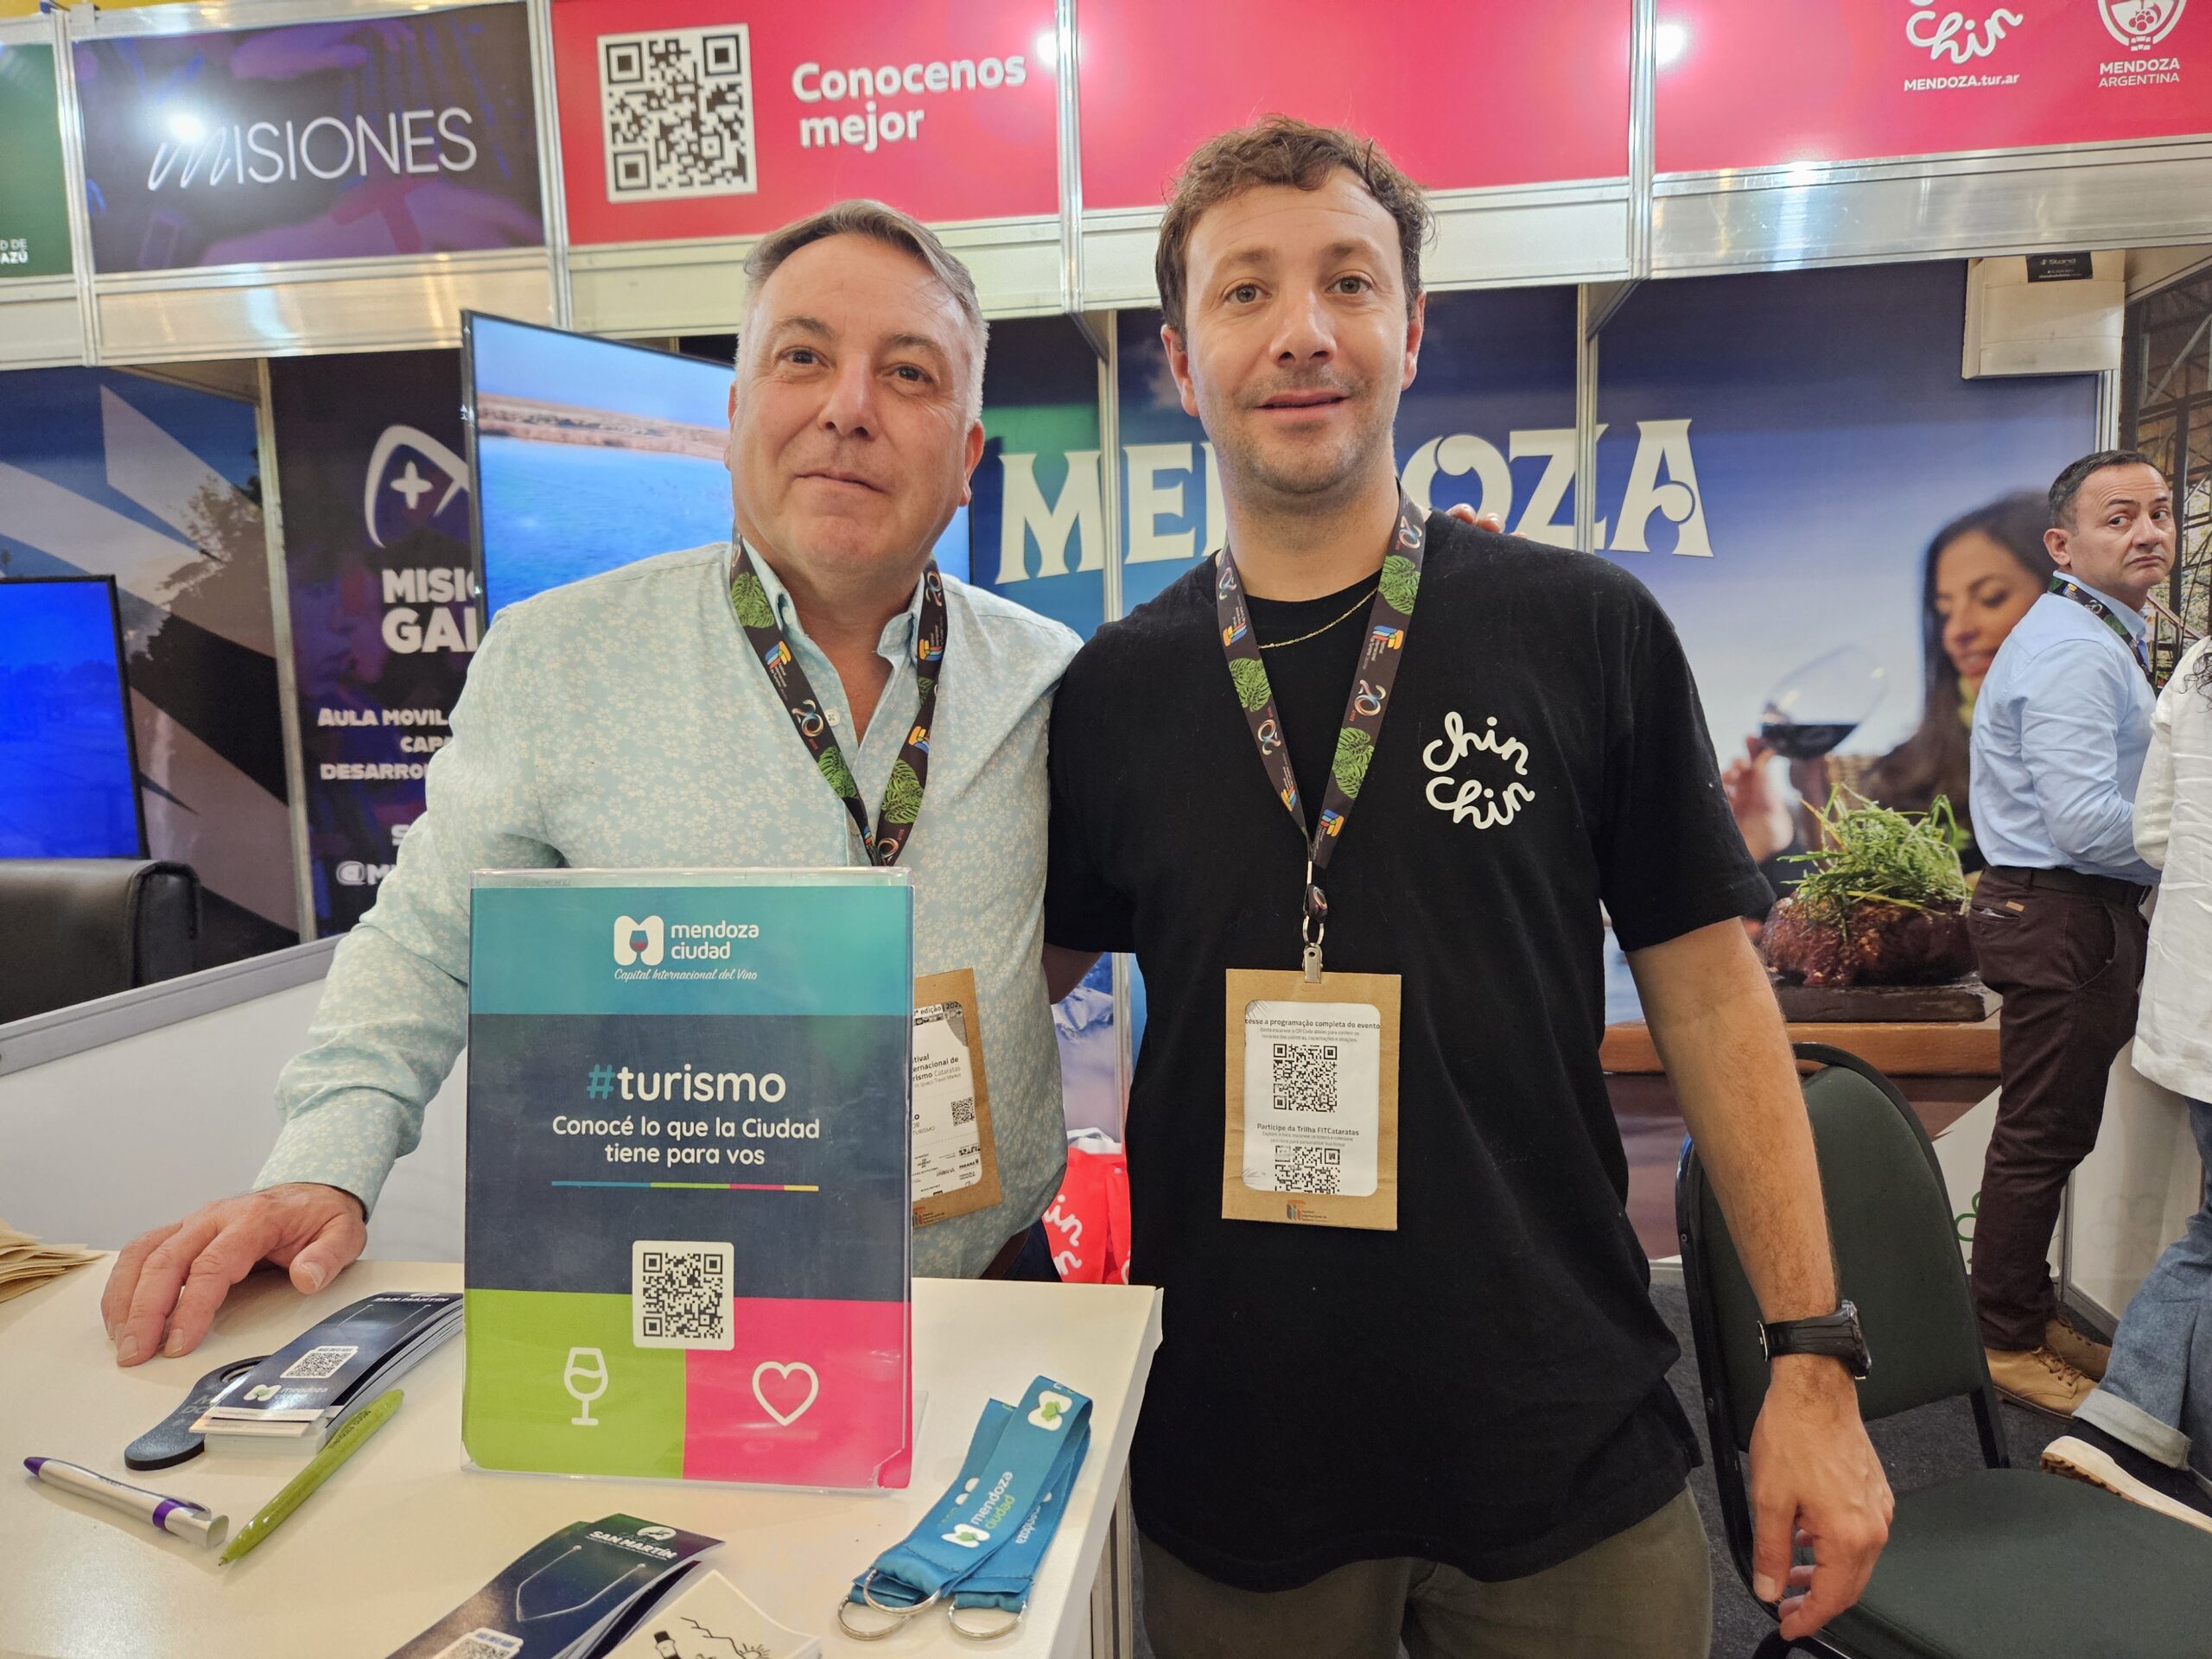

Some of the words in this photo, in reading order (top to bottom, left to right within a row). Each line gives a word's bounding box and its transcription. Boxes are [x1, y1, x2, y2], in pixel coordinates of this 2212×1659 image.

[2100, 57, 2180, 75] MENDOZA
[792, 54, 1027, 103] Conocenos
[1904, 74, 2020, 92] MENDOZA.tur.ar
[2098, 72, 2180, 88] ARGENTINA
[800, 104, 925, 152] mejor
[11, 239, 28, 250] DE
[0, 248, 29, 264] AZÚ
[995, 418, 1713, 585] MEOZA
[317, 708, 379, 727] AULA
[671, 920, 760, 939] mendoza
[671, 941, 731, 960] ciudad
[614, 968, 652, 983] Capital
[652, 969, 717, 981] Internacional
[718, 969, 735, 980] del
[737, 969, 758, 981] Vino
[1270, 1020, 1313, 1028] programação
[913, 1053, 930, 1064] tival
[913, 1058, 949, 1073] ernacional
[586, 1064, 786, 1103] #turismo
[913, 1072, 933, 1083] rismo
[552, 1114, 634, 1136] Conocé
[641, 1116, 661, 1137] lo
[667, 1119, 709, 1141] que
[715, 1116, 734, 1137] la
[741, 1118, 820, 1140] Ciudad
[1257, 1123, 1286, 1132] Participe
[1318, 1127, 1359, 1136] FITCataratas
[605, 1143, 660, 1163] tiene
[667, 1147, 720, 1168] para
[727, 1148, 766, 1166] vos
[970, 1471, 1014, 1525] mendoza
[985, 1495, 1015, 1529] ciudad
[589, 1531, 622, 1544] SAN
